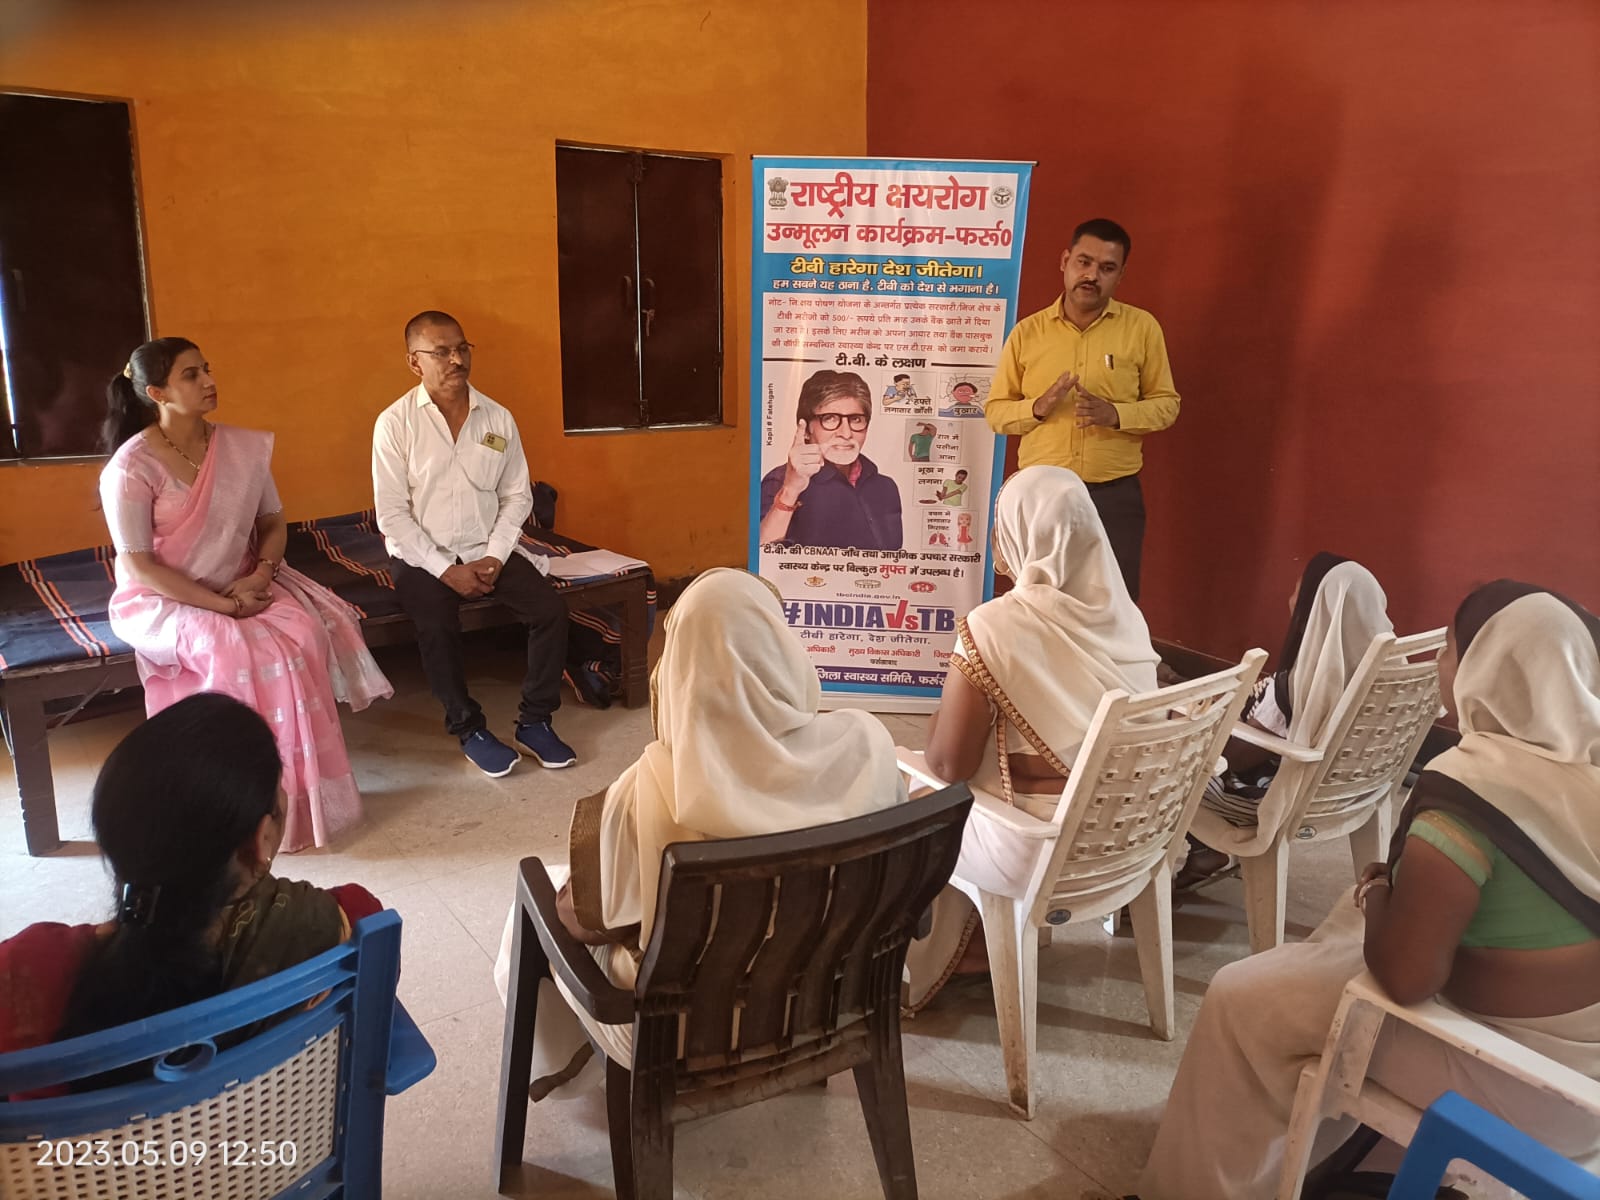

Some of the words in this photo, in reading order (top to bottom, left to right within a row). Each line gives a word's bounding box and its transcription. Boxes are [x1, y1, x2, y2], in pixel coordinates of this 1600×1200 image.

[790, 171, 879, 219] राष्ट्रीय
[886, 175, 990, 211] क्षयरोग
[766, 222, 851, 249] उन्मूलन
[790, 256, 825, 274] टीबी
[829, 258, 879, 275] हारेगा
[882, 259, 912, 276] देश
[773, 279, 789, 289] हम
[792, 278, 817, 289] सबने
[820, 280, 835, 290] यह
[838, 281, 860, 290] ठाना
[877, 279, 897, 291] टीबी
[900, 281, 914, 292] को
[917, 281, 934, 292] देश
[937, 281, 947, 293] से
[949, 283, 983, 294] भगाना
[838, 299, 861, 308] योजना
[864, 299, 871, 308] के
[993, 303, 1001, 312] के
[893, 316, 908, 324] माह
[911, 315, 928, 324] उनके
[974, 316, 991, 326] दिया
[773, 326, 783, 334] जा
[785, 326, 797, 334] रहा
[873, 328, 882, 337] को
[886, 329, 906, 337] अपना
[884, 343, 894, 351] पर
[938, 343, 947, 352] को
[949, 345, 966, 353] जमा
[835, 351, 870, 367] टी.बी.
[874, 354, 889, 367] के
[892, 357, 927, 369] लक्षण
[884, 406, 911, 414] लगातार
[954, 407, 978, 416] बुखार
[789, 545, 802, 555] की
[804, 546, 838, 557] CBNAAT
[862, 550, 878, 558] तथा
[880, 549, 918, 563] आधुनिक
[920, 552, 948, 561] उपचार
[949, 552, 981, 563] सरकारी
[779, 562, 808, 570] स्वास्थ्य
[811, 561, 831, 572] केन्द्र
[833, 564, 845, 572] पर
[880, 564, 907, 579] मुफ्त
[909, 566, 919, 575] में
[868, 632, 885, 643] देश
[817, 667, 841, 681] जिला
[844, 671, 878, 682] स्वास्थ्य
